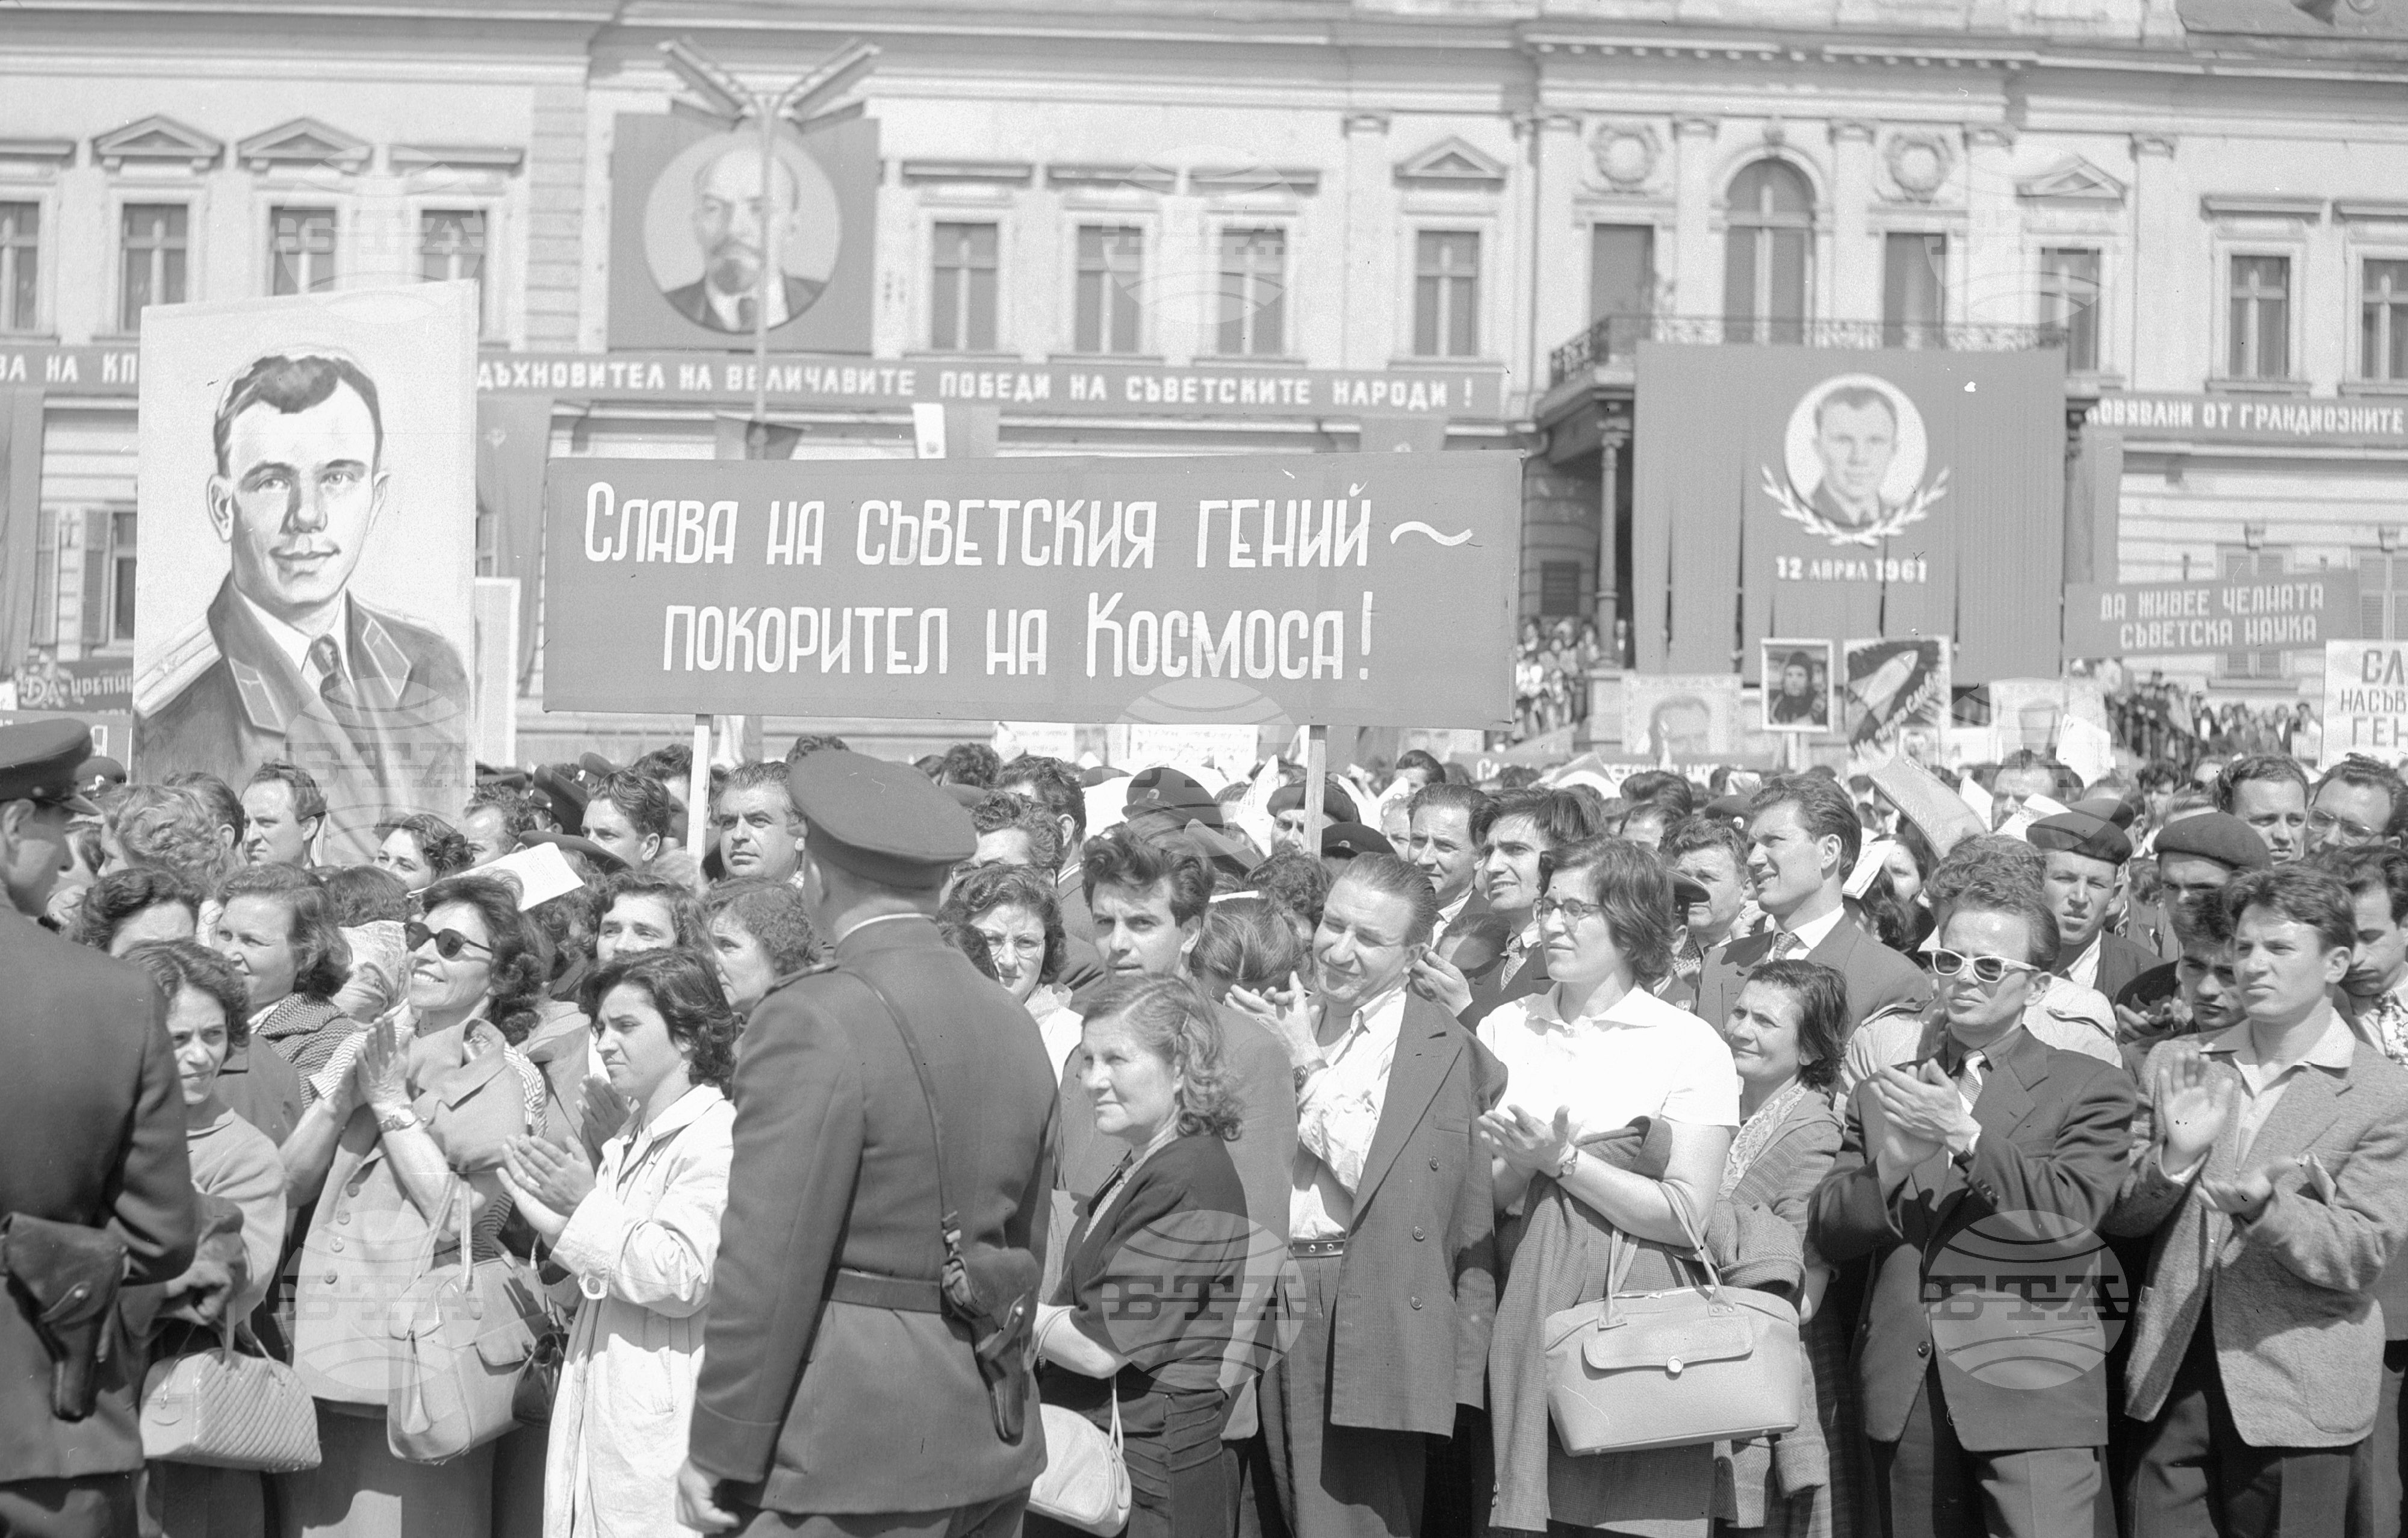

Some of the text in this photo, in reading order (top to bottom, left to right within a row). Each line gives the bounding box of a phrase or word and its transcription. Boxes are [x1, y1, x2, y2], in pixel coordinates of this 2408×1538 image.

[46, 355, 79, 382] НА
[477, 361, 665, 390] ДЪХНОВИТЕЛ
[679, 364, 713, 390] НА
[726, 364, 916, 395] ВЕЛИЧАВИТЕ
[939, 371, 1050, 402] ПОБЕДИ
[1070, 374, 1106, 401] НА
[1126, 376, 1311, 405] СЪВЕТСКИТЕ
[1333, 379, 1447, 411] НАРОДИ
[2203, 402, 2233, 429] ОТ
[2239, 403, 2404, 436] ГРАНДИОЗНИТЕ
[1776, 556, 1802, 580] 12
[1874, 557, 1927, 583] 1961
[2100, 582, 2325, 621] ДА ЖИВЕЕ ЧЕЛНАТА
[2120, 615, 2317, 650] СЪВЕТСКА НАУКА
[2362, 650, 2407, 686] СЛ
